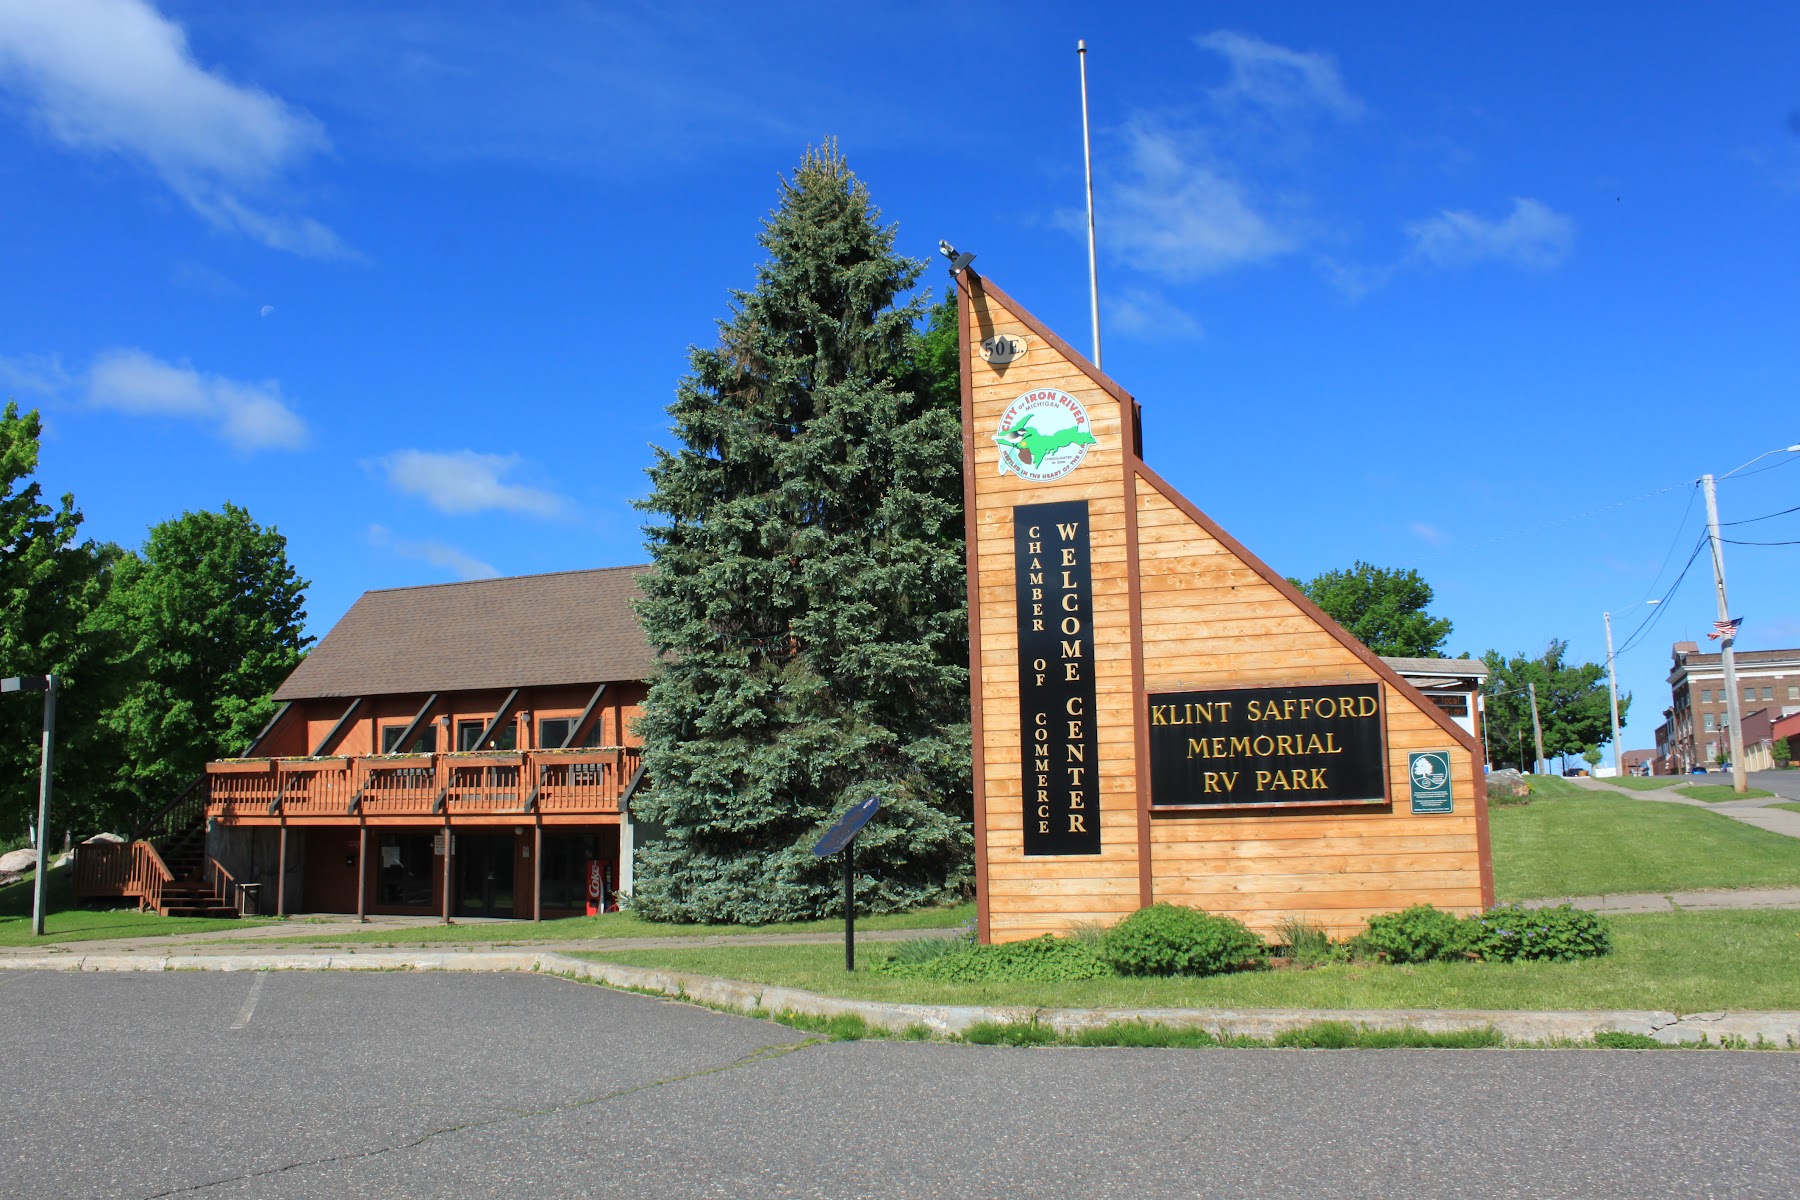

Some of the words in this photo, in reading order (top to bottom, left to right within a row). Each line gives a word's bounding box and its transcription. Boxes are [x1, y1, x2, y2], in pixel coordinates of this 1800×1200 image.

[1001, 405, 1018, 432] CITY
[1024, 391, 1057, 404] IRON
[1059, 395, 1085, 425] RIVER
[1025, 401, 1060, 411] MICHIGAN
[1042, 470, 1062, 479] HEART
[1062, 464, 1071, 472] OF
[1069, 455, 1080, 466] THE
[1028, 526, 1045, 631] CHAMBER
[1056, 522, 1082, 681] WELCOME
[1033, 658, 1046, 686] OF
[1151, 701, 1232, 725] KLINT
[1247, 696, 1378, 721] SAFFORD
[1186, 732, 1342, 759] MEMORIAL
[1034, 712, 1050, 834] COMMERCE
[1066, 697, 1087, 833] CENTER
[1203, 771, 1239, 793] RV
[1255, 768, 1328, 792] PARK
[588, 860, 600, 898] Coke
